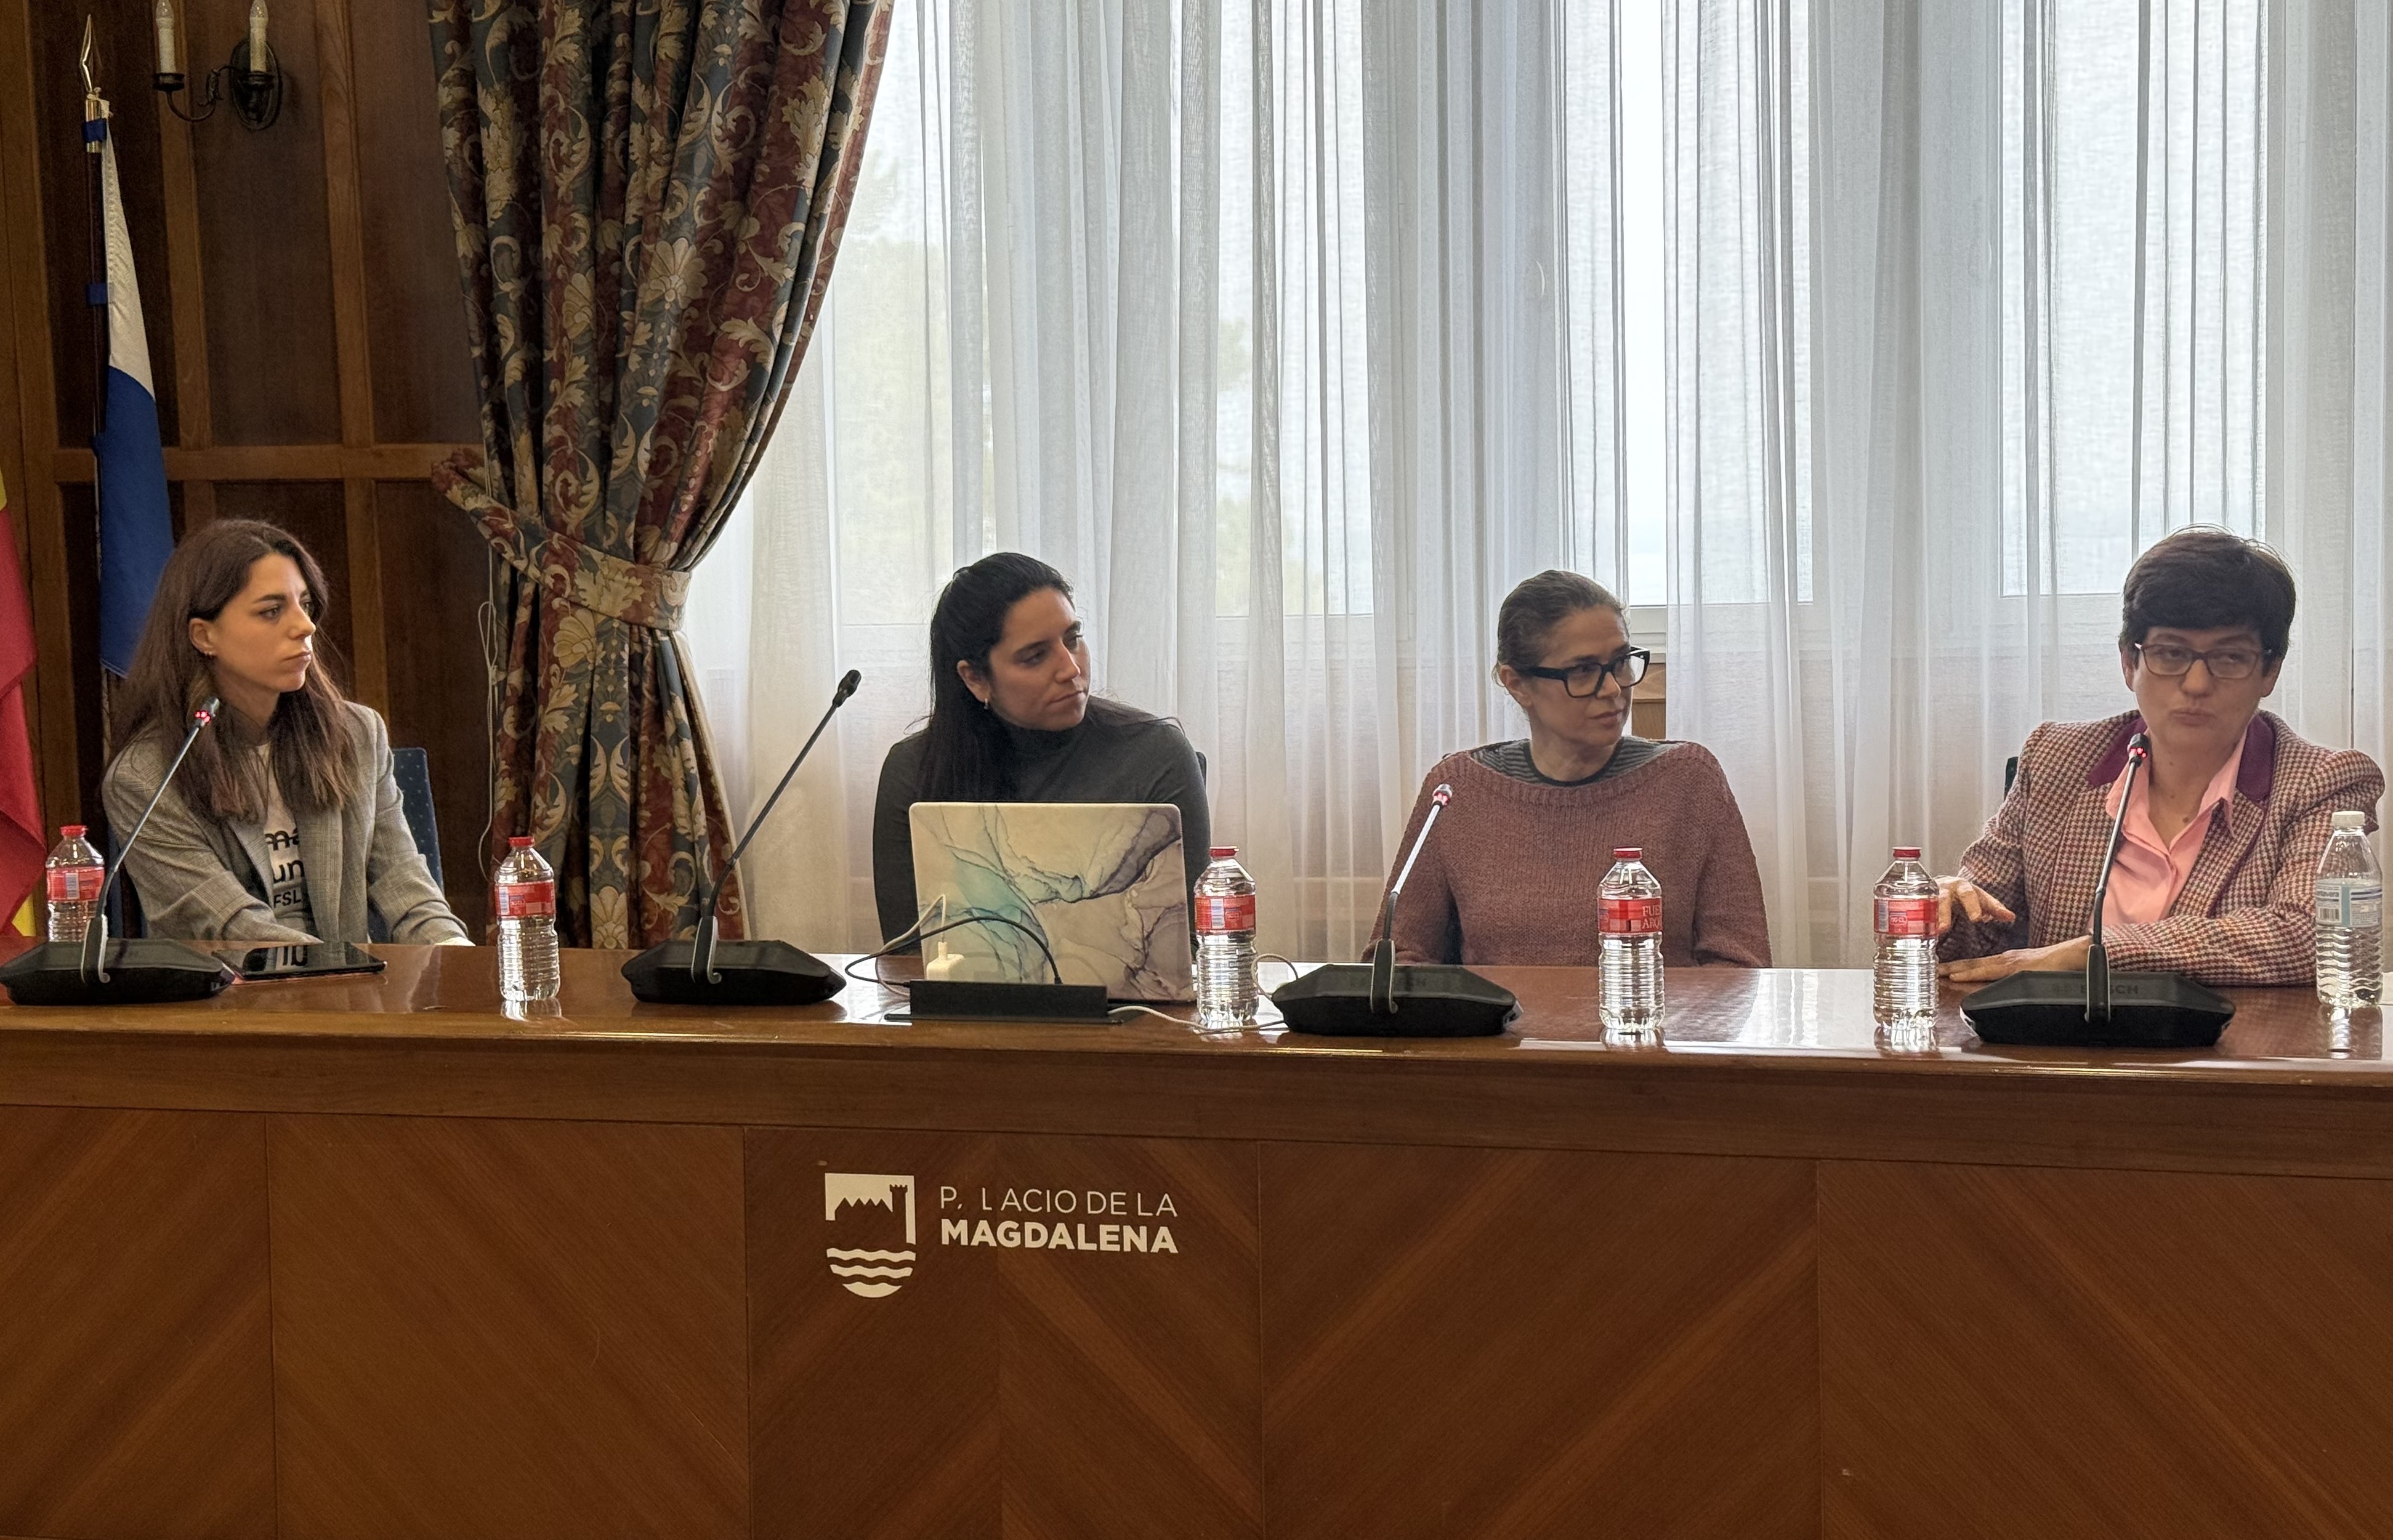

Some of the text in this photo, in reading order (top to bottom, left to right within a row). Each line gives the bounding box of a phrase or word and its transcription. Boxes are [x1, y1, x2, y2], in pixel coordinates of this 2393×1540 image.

[2081, 984, 2138, 994] BSCH
[940, 1186, 1178, 1217] PLACIO DE LA
[941, 1219, 1179, 1254] MAGDALENA
